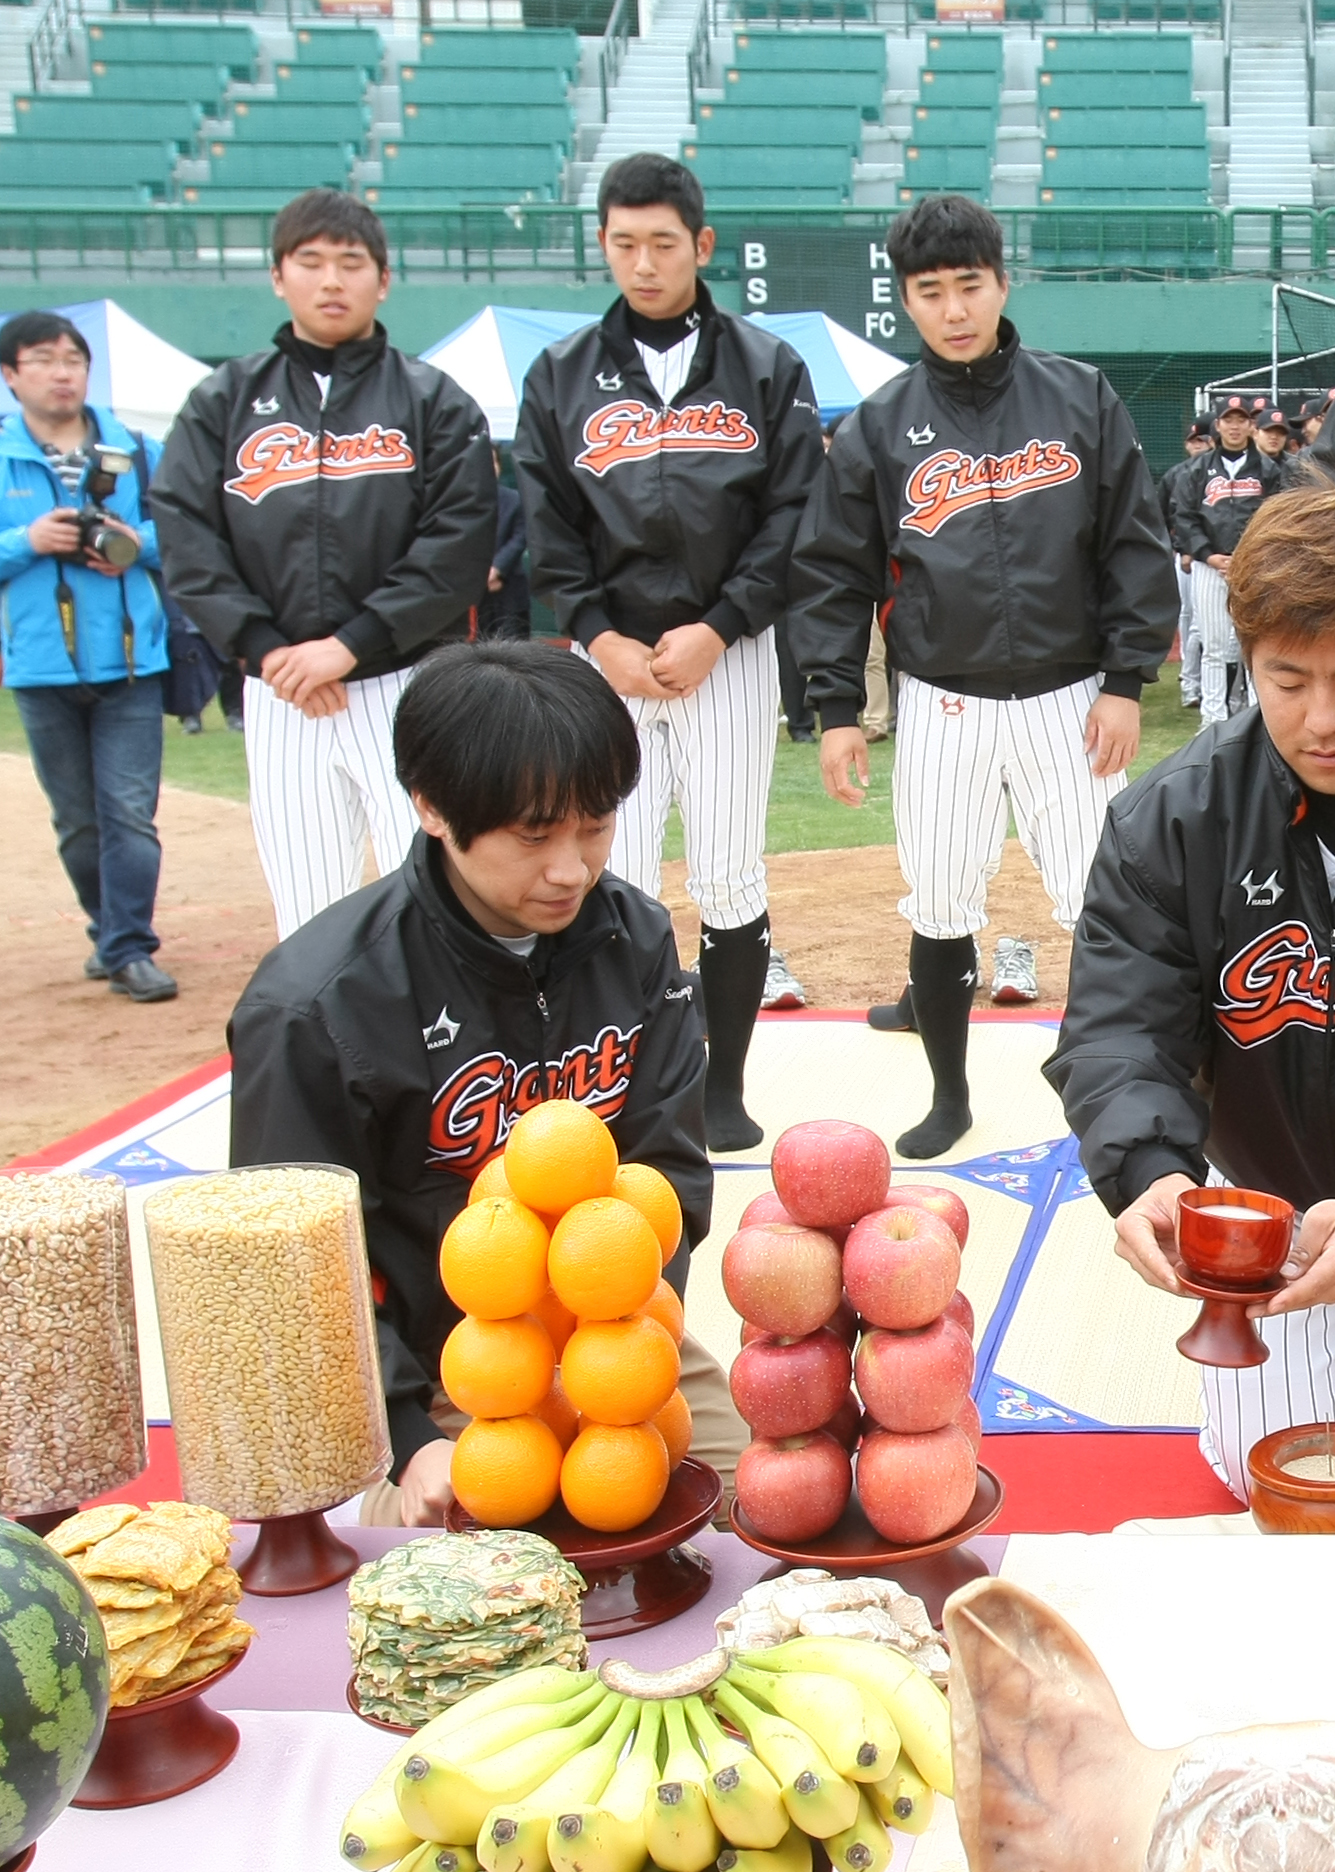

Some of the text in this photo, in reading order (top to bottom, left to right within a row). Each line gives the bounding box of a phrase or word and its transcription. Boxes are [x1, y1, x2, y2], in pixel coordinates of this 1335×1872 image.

[744, 242, 767, 270] B
[869, 243, 891, 270] H
[746, 277, 768, 304] S
[872, 277, 892, 303] E
[865, 311, 896, 338] FC
[574, 399, 759, 477] Giants
[224, 422, 416, 505] Giants
[900, 439, 1082, 538] Giants
